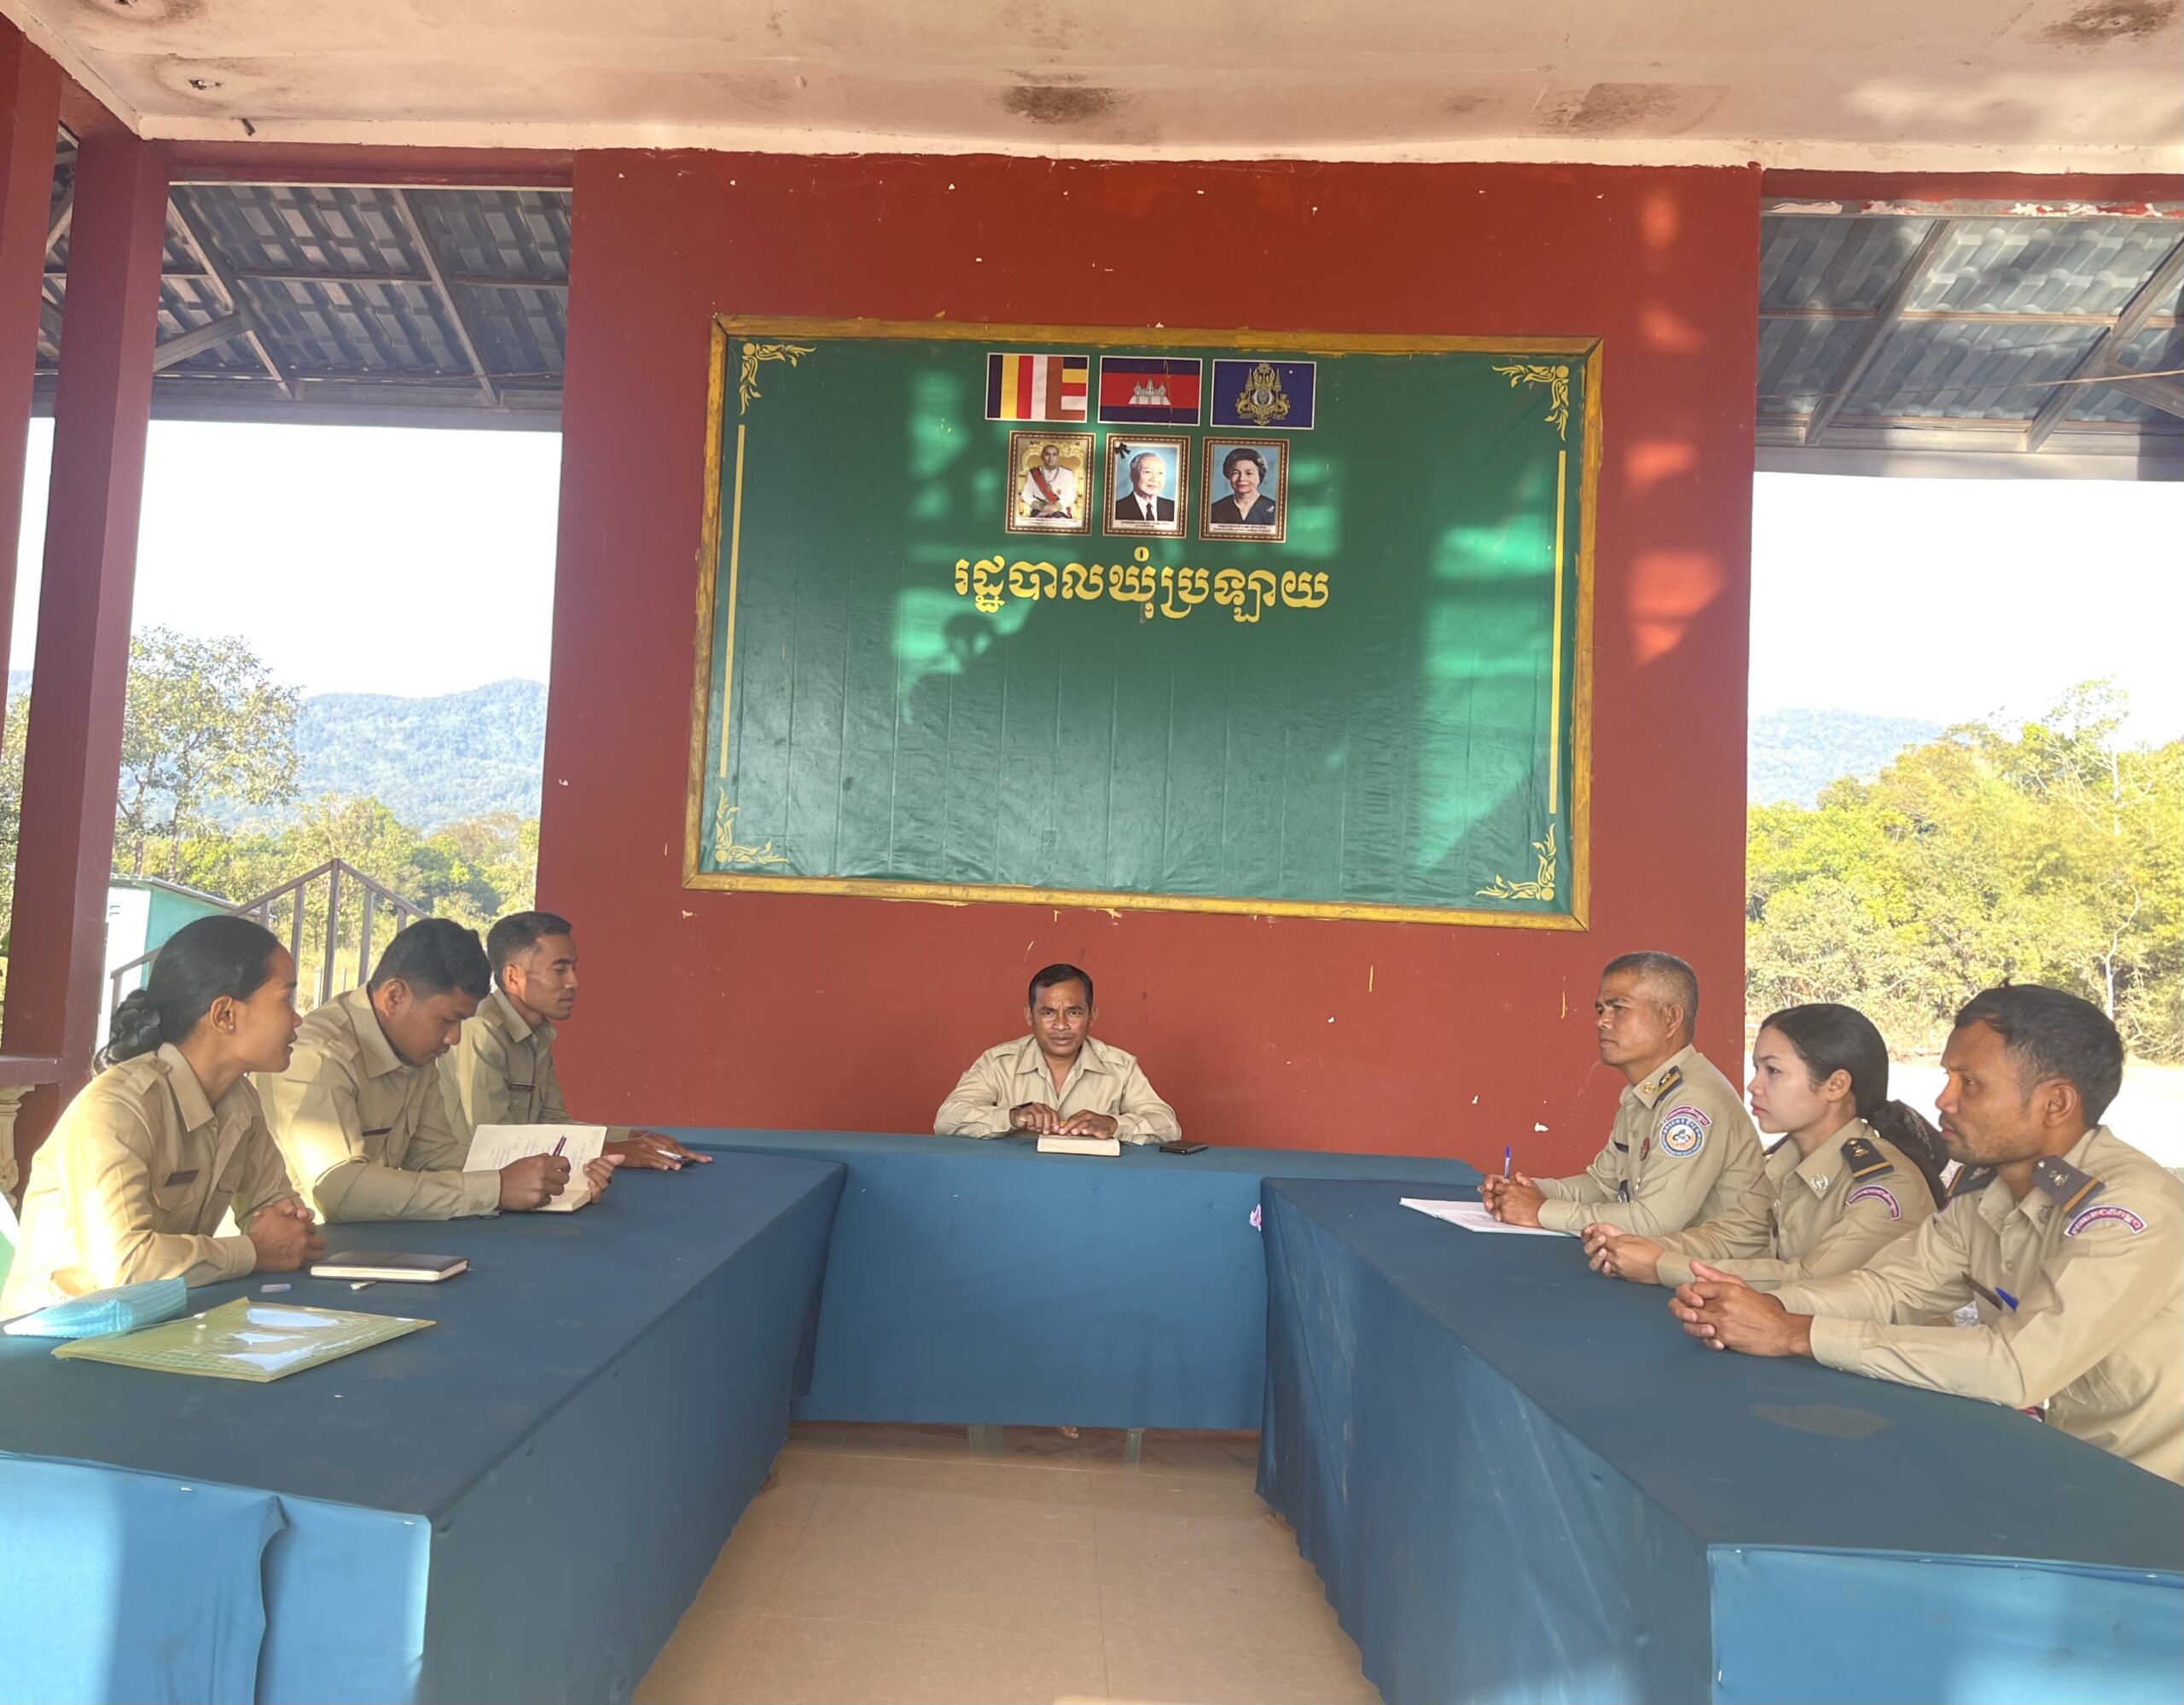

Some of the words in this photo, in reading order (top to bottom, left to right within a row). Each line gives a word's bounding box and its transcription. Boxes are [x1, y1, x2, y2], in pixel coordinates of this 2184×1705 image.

[955, 546, 1329, 623] រដ្ឋបាលឃុំប្រឡាយ
